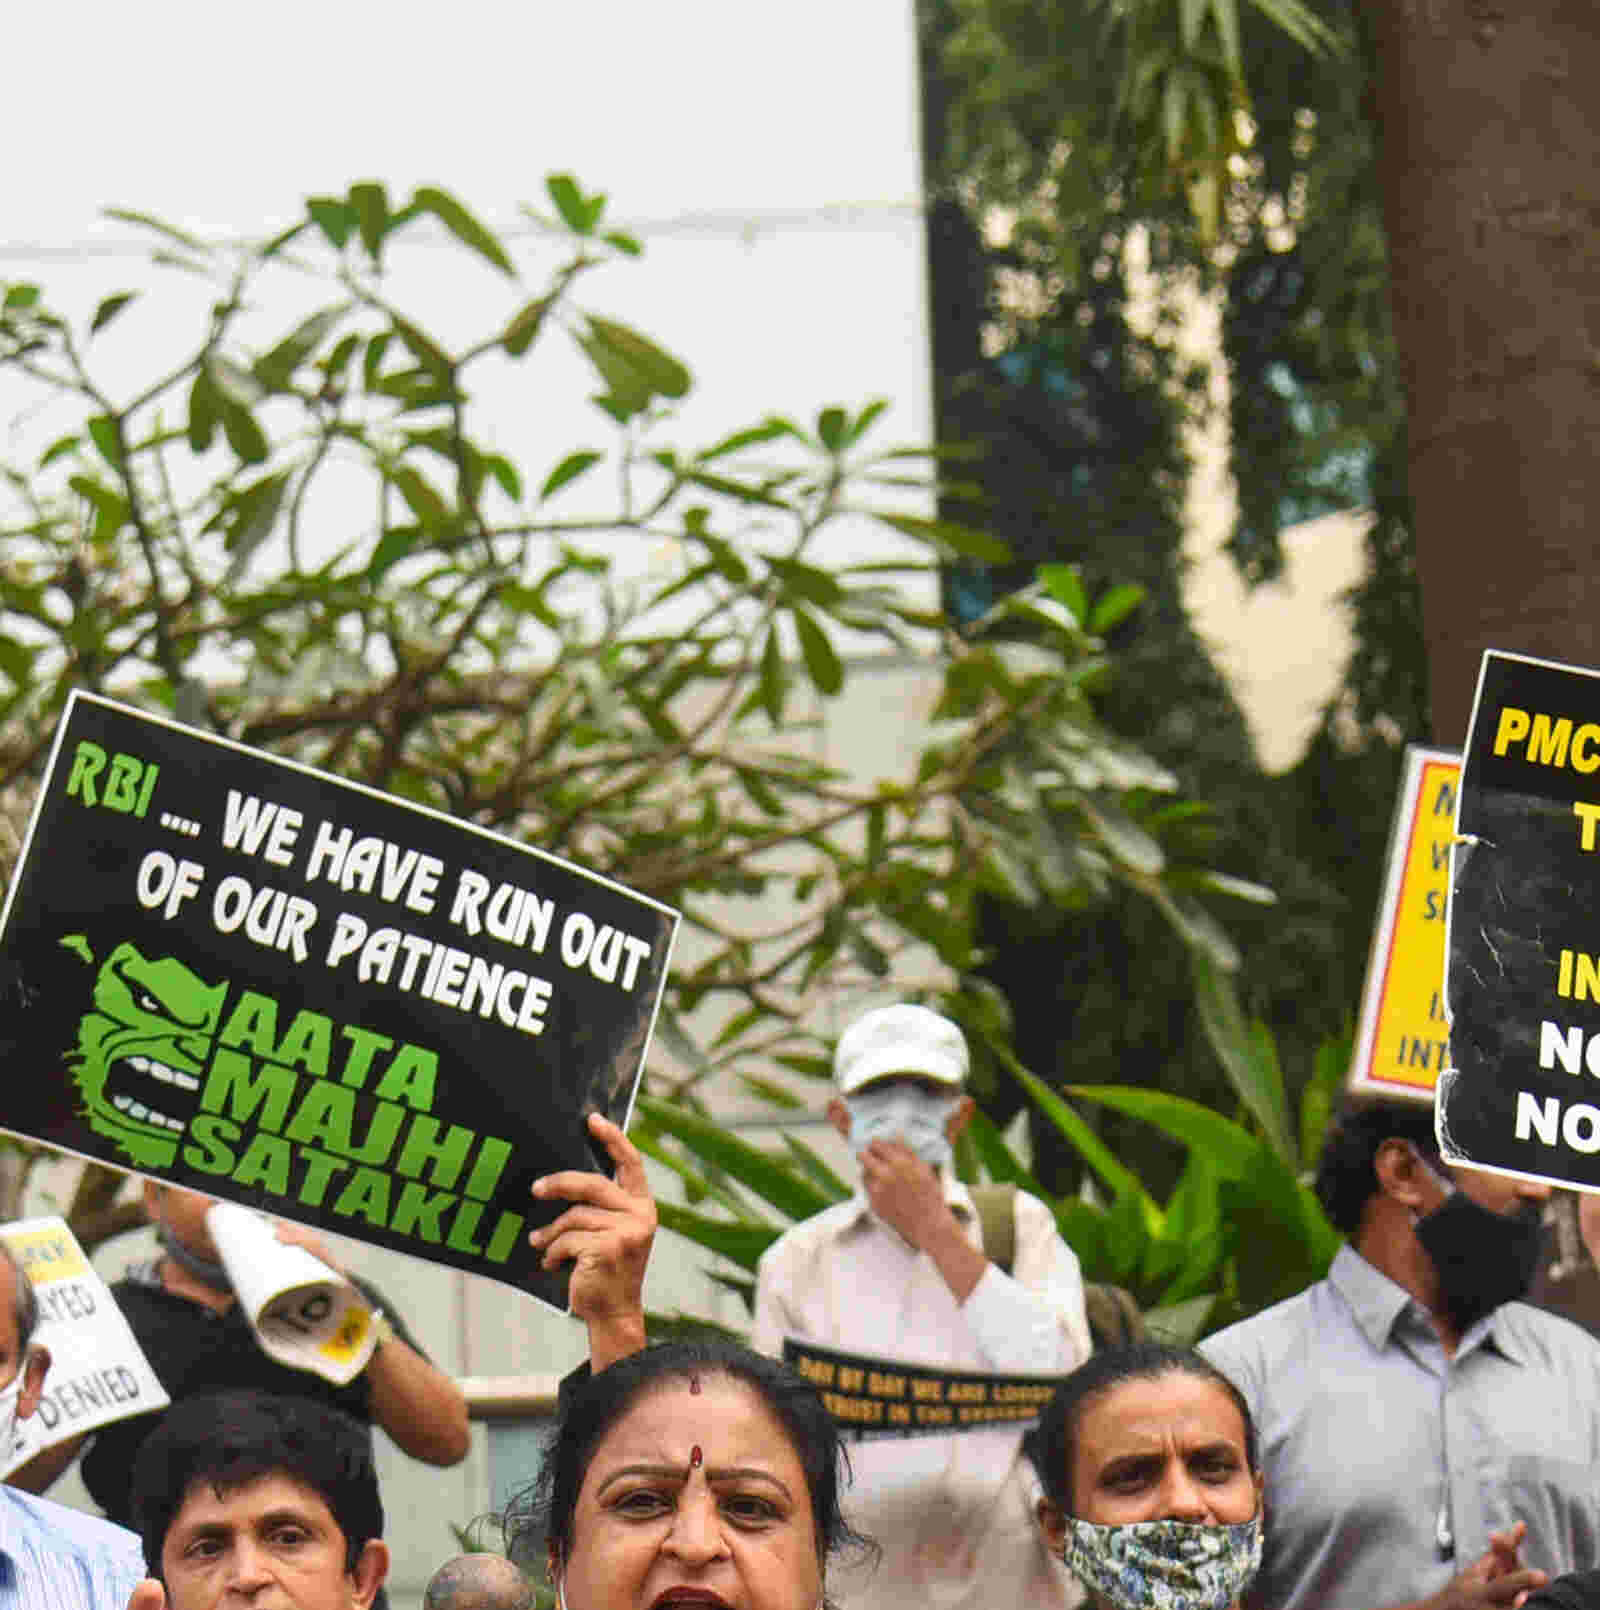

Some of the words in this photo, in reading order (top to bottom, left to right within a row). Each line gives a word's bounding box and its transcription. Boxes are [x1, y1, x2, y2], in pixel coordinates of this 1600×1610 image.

[65, 740, 160, 818] RBI
[222, 789, 302, 865] WE
[306, 820, 443, 915] HAVE
[450, 869, 554, 954] RUN
[560, 913, 650, 992] OUT
[136, 850, 204, 921] OF
[212, 877, 317, 963] OUR
[326, 911, 553, 1035] PATIENCE
[198, 1046, 513, 1200] MAJHI
[221, 989, 440, 1108] AATA
[183, 1115, 525, 1264] SATAKLI
[38, 1365, 141, 1431] DENIED
